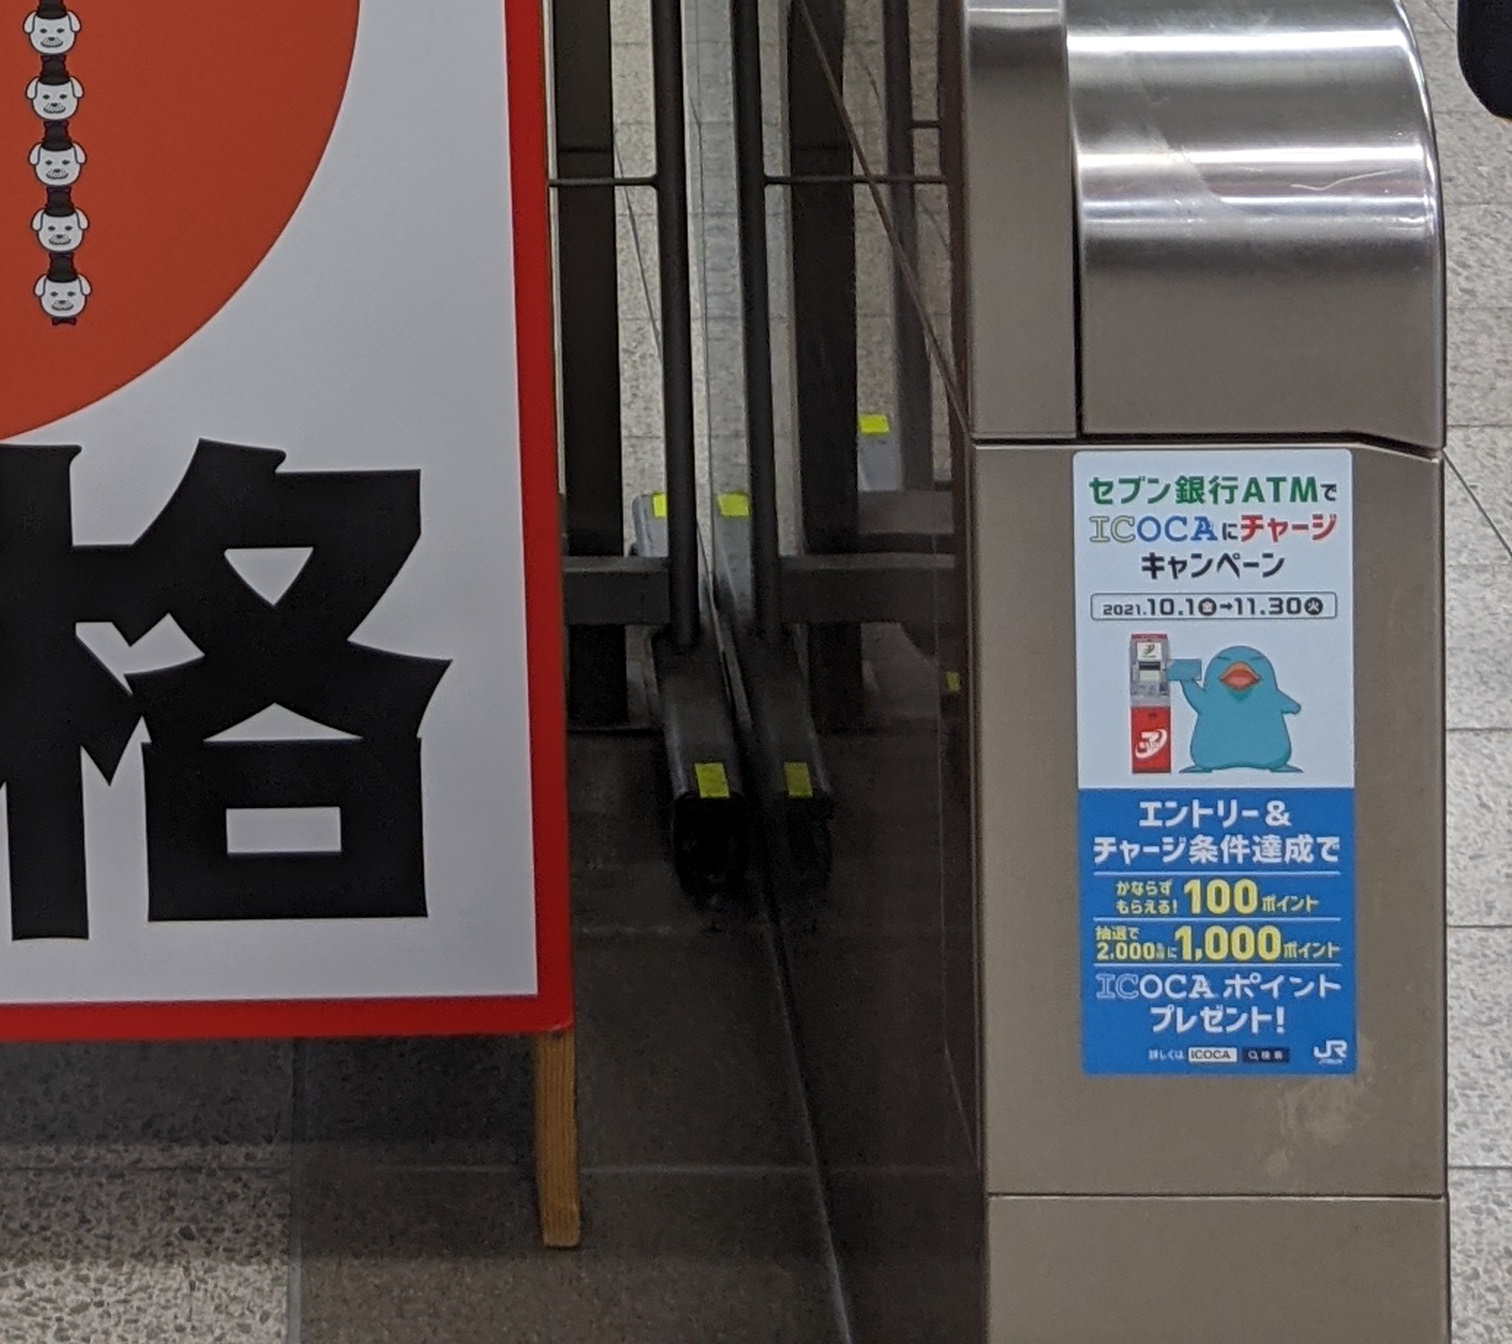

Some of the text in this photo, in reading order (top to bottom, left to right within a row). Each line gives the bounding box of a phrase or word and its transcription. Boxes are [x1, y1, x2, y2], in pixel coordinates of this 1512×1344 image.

[1088, 474, 1337, 505] セブン銀行ATMで
[1088, 513, 1337, 543] ICOCAにチャージ
[1140, 551, 1285, 580] キャンペーン
[1138, 798, 1292, 828] エントリー&
[1092, 833, 1341, 865] チャージ条件達成で
[1115, 879, 1173, 897] かならず
[1095, 925, 1140, 942] 抽選で
[1096, 972, 1342, 1000] ICOCA ポイント
[1190, 1048, 1232, 1060] ICOCA
[1313, 1039, 1348, 1059] JR
